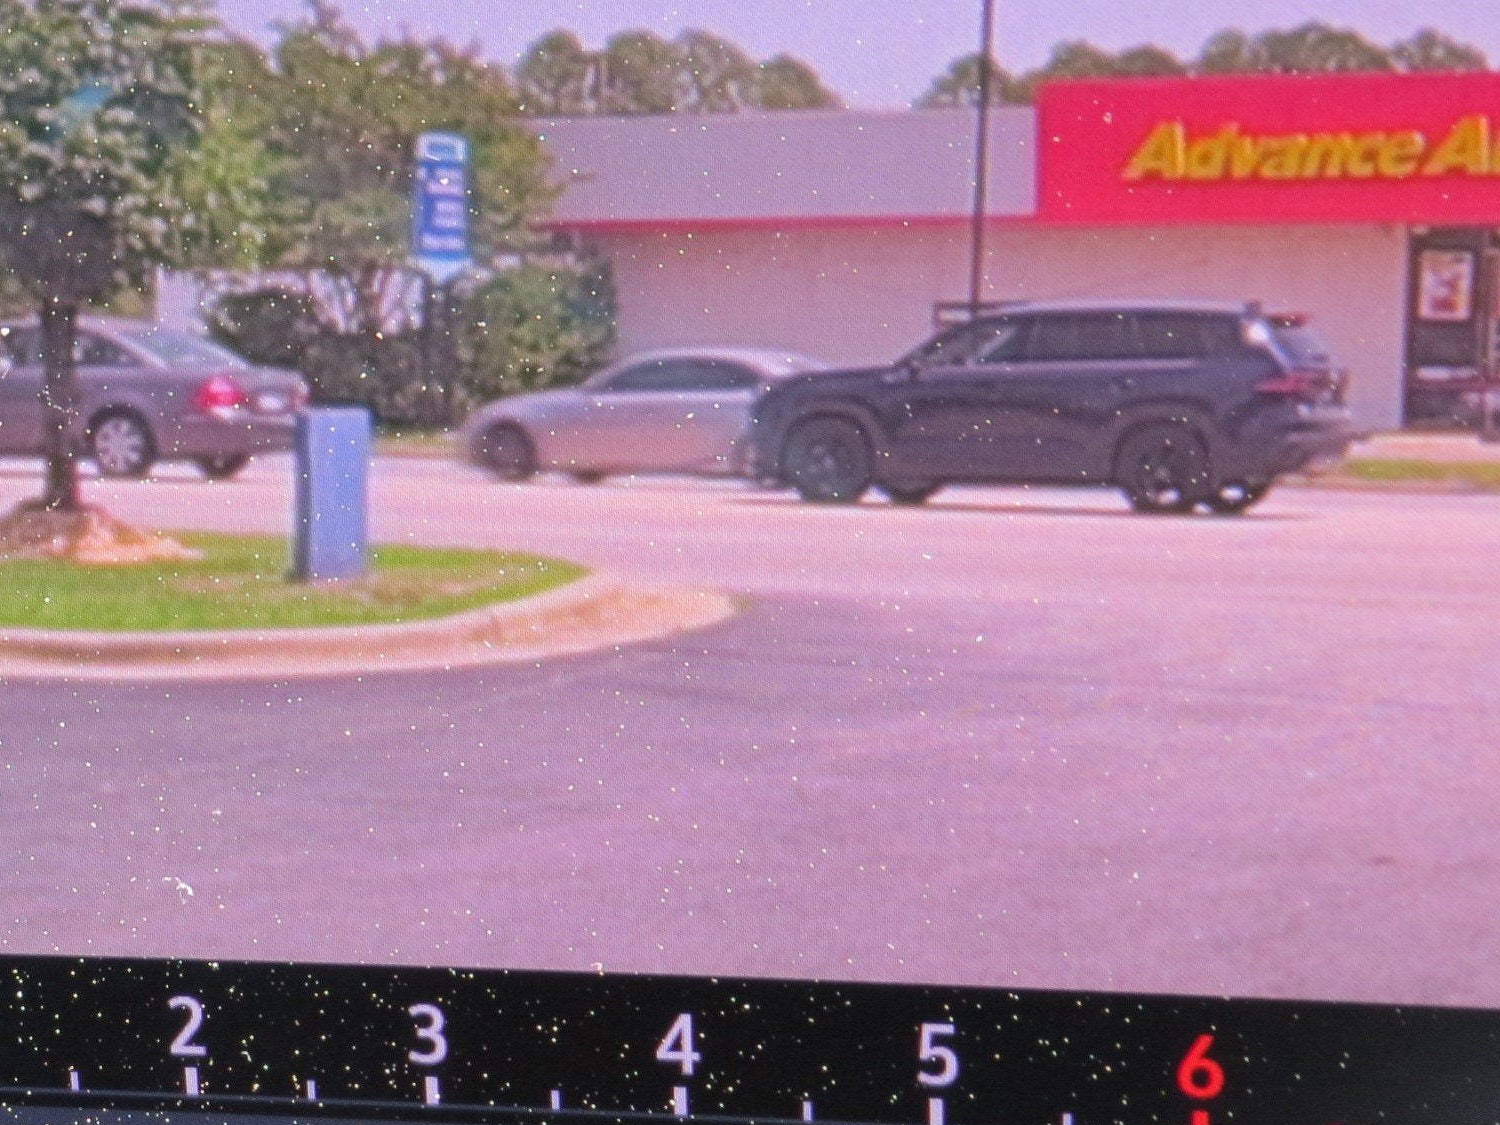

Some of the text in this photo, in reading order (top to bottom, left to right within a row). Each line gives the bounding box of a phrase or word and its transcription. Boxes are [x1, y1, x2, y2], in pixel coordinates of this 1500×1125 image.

[1121, 113, 1500, 181] Advance A
[167, 995, 206, 1057] 2
[407, 1004, 448, 1065] 3
[655, 1013, 702, 1075] 4
[917, 1023, 960, 1087] 5
[1177, 1034, 1224, 1098] 6
